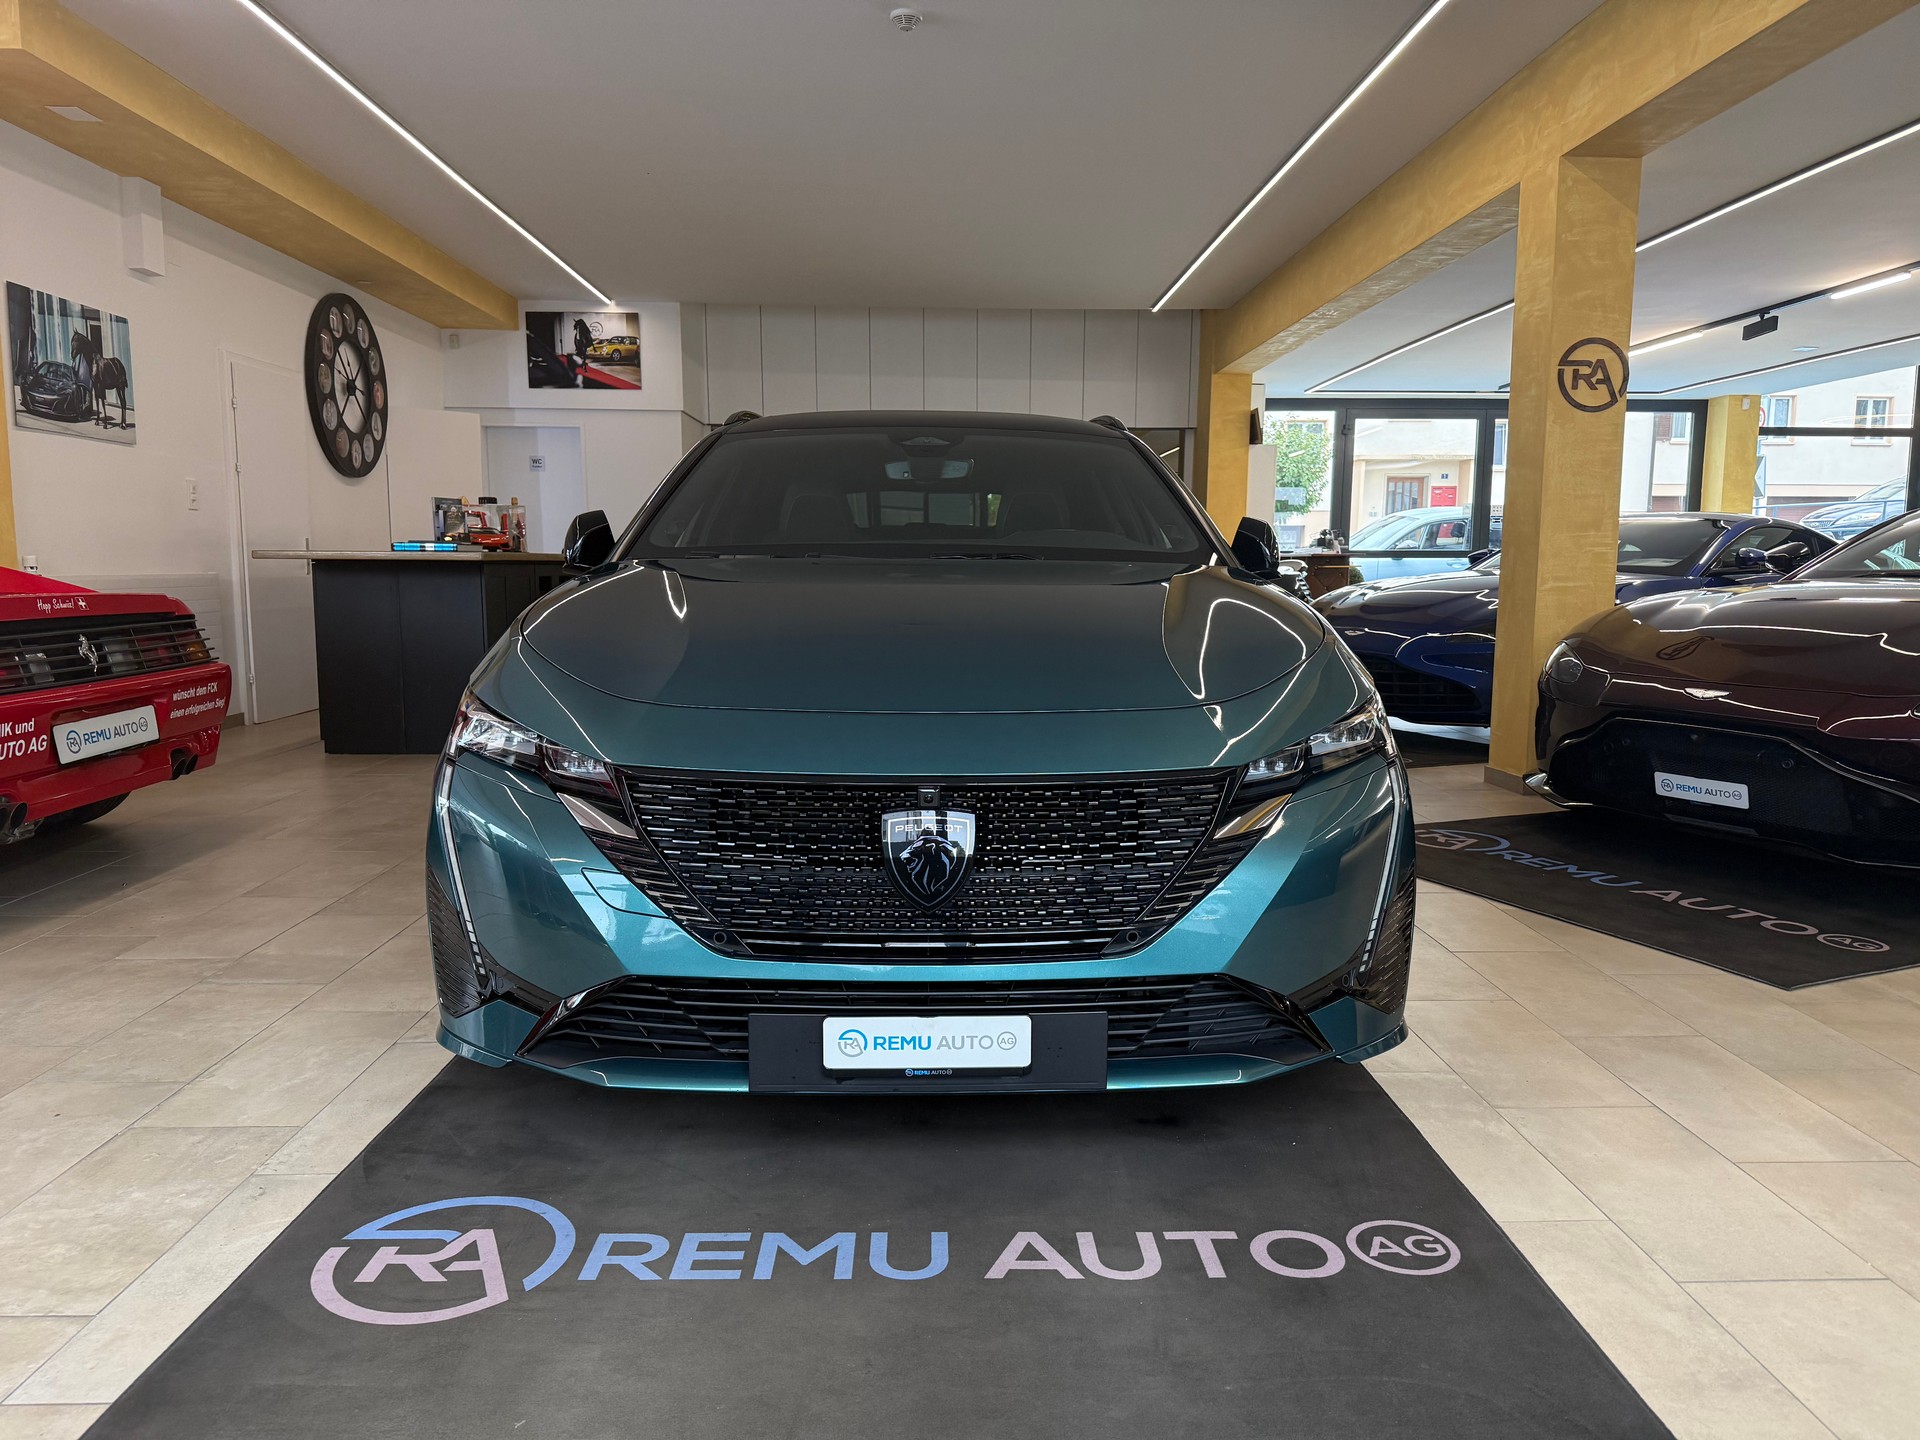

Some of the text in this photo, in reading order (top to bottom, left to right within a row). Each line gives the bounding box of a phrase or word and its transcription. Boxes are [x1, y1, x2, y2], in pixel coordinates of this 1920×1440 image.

[172, 687, 196, 702] wünscht
[207, 682, 218, 694] FCK
[170, 708, 185, 719] einen
[184, 701, 215, 716] erfolgreichen
[15, 717, 35, 735] und
[83, 728, 112, 746] REMU
[113, 721, 139, 739] AUTO
[27, 734, 48, 754] AG
[1676, 783, 1702, 794] REMU
[1704, 788, 1731, 799] AUTO
[895, 823, 963, 833] PEUGEOT
[1485, 850, 1643, 887] REMU
[1630, 889, 1819, 936] AUTO
[873, 1035, 932, 1051] REMU
[936, 1035, 993, 1050] AUTO
[576, 1231, 949, 1281] REMU
[983, 1229, 1346, 1281] AUTO
